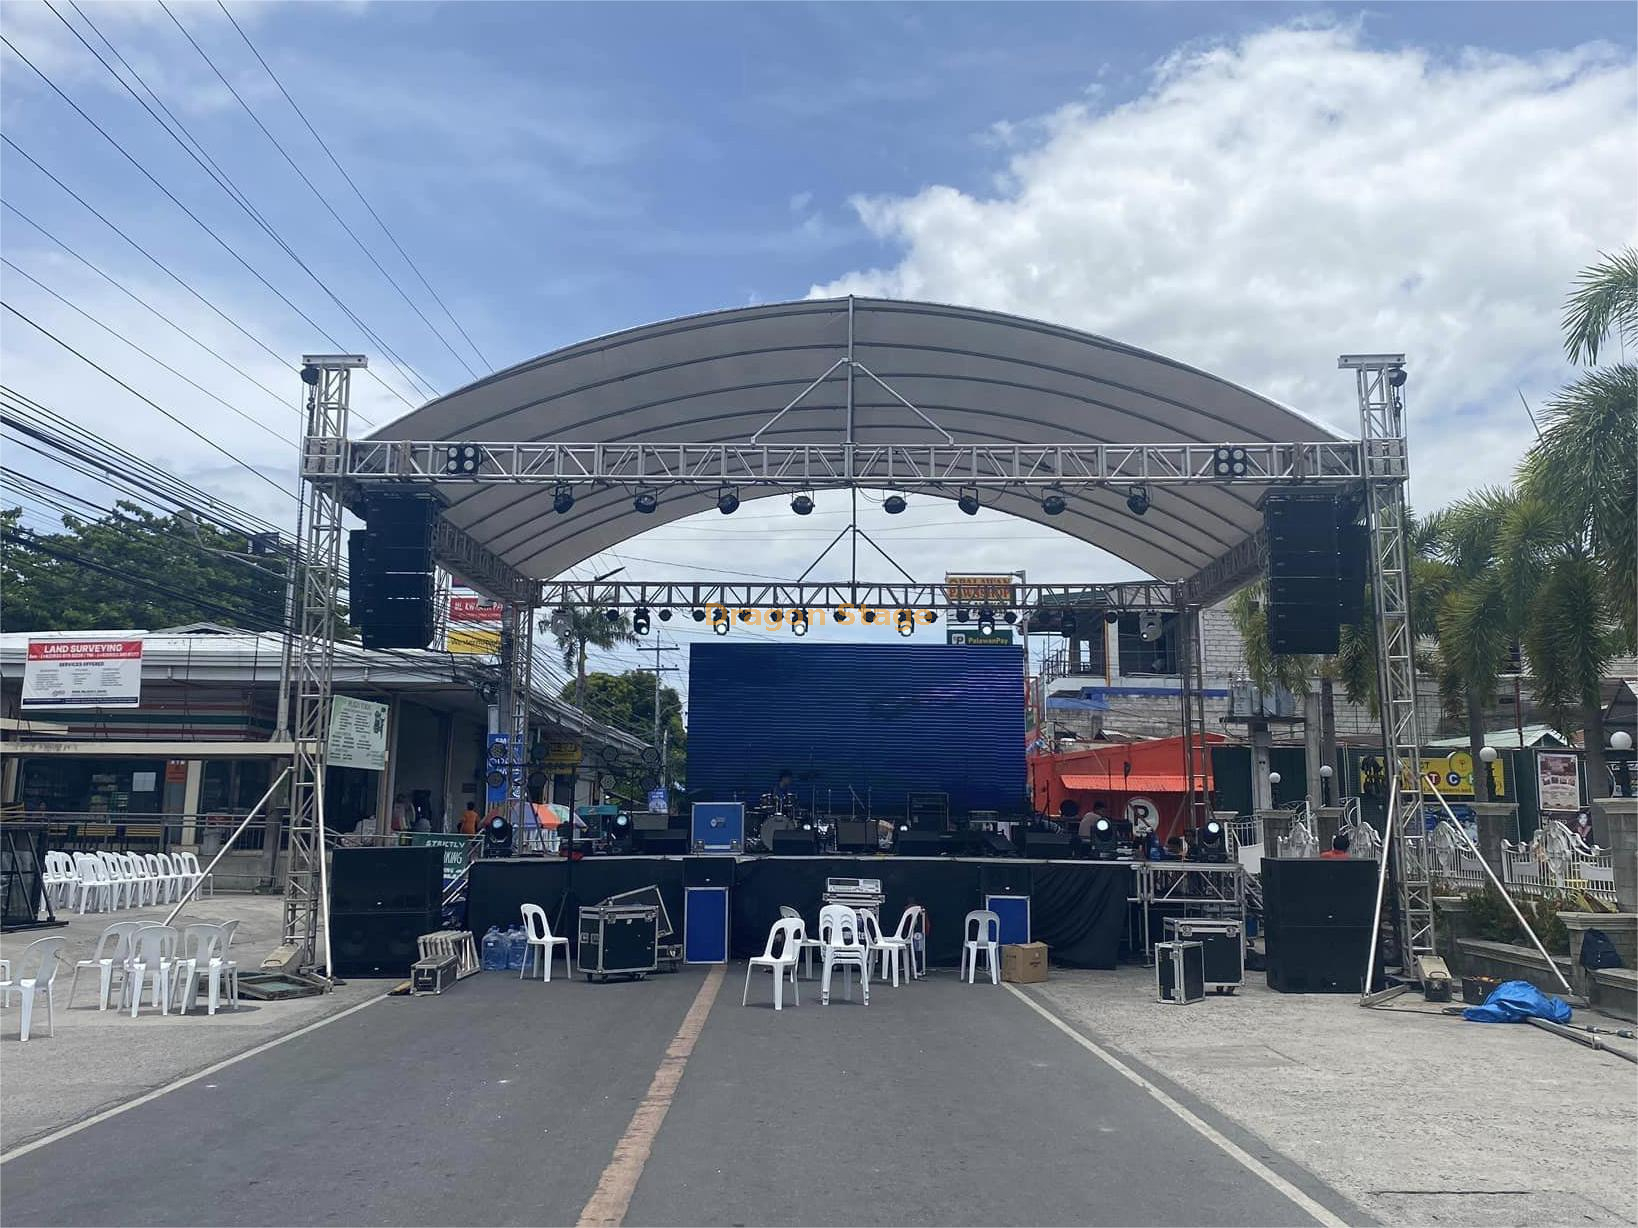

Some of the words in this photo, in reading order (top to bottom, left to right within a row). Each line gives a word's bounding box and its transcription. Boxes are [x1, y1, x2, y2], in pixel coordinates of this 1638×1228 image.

[44, 645, 69, 653] LAND
[70, 644, 123, 653] SURVEYING
[1133, 805, 1151, 828] R
[443, 851, 463, 864] KING
